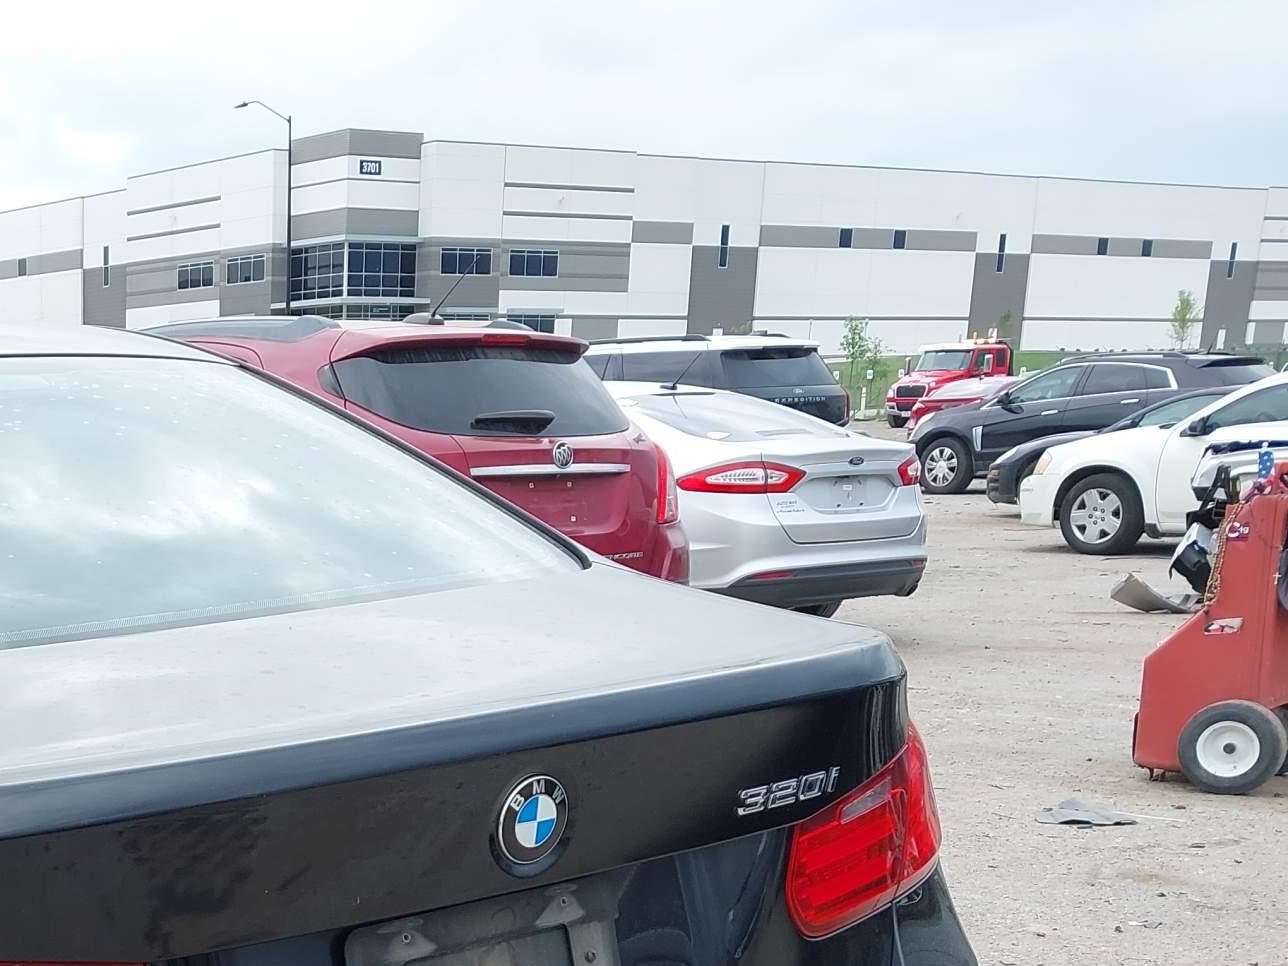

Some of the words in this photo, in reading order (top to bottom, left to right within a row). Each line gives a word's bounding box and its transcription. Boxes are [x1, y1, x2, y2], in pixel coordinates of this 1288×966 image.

[362, 161, 379, 173] 3701
[510, 780, 565, 812] BMW
[737, 766, 841, 816] 320i
